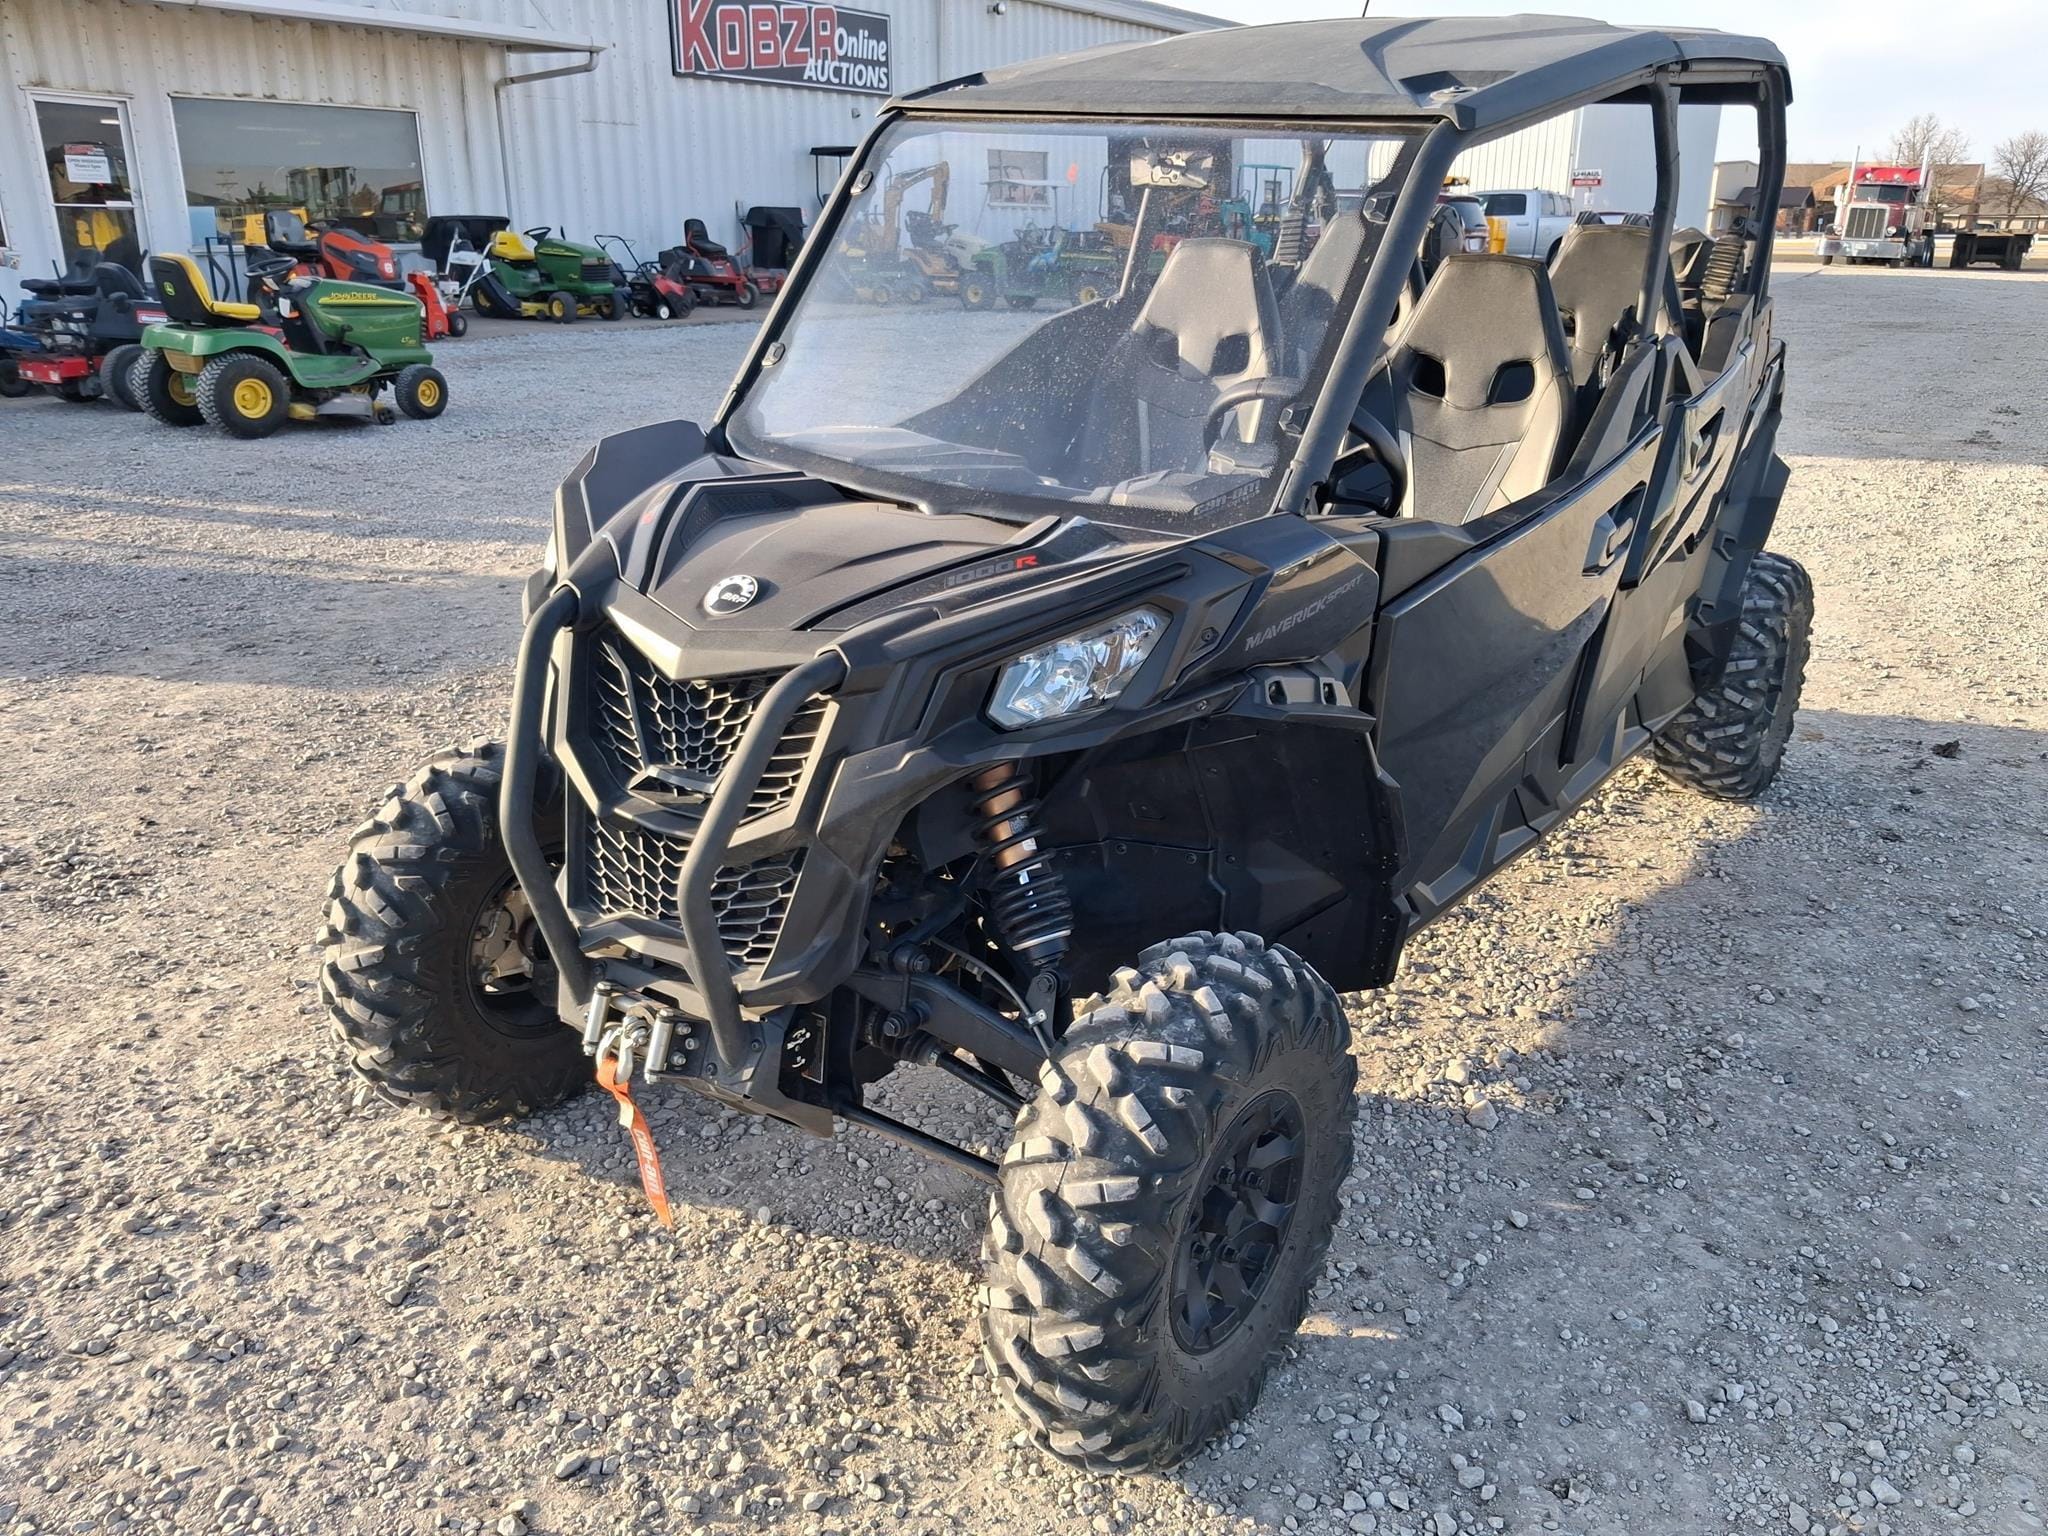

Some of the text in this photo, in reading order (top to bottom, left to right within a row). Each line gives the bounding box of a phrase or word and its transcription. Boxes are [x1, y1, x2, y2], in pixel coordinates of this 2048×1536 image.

[677, 0, 839, 73] KOBZA
[834, 27, 887, 62] Online
[803, 58, 889, 90] AUCTIONS
[720, 591, 748, 603] BRP
[1244, 572, 1364, 652] MAVERICK SPORT
